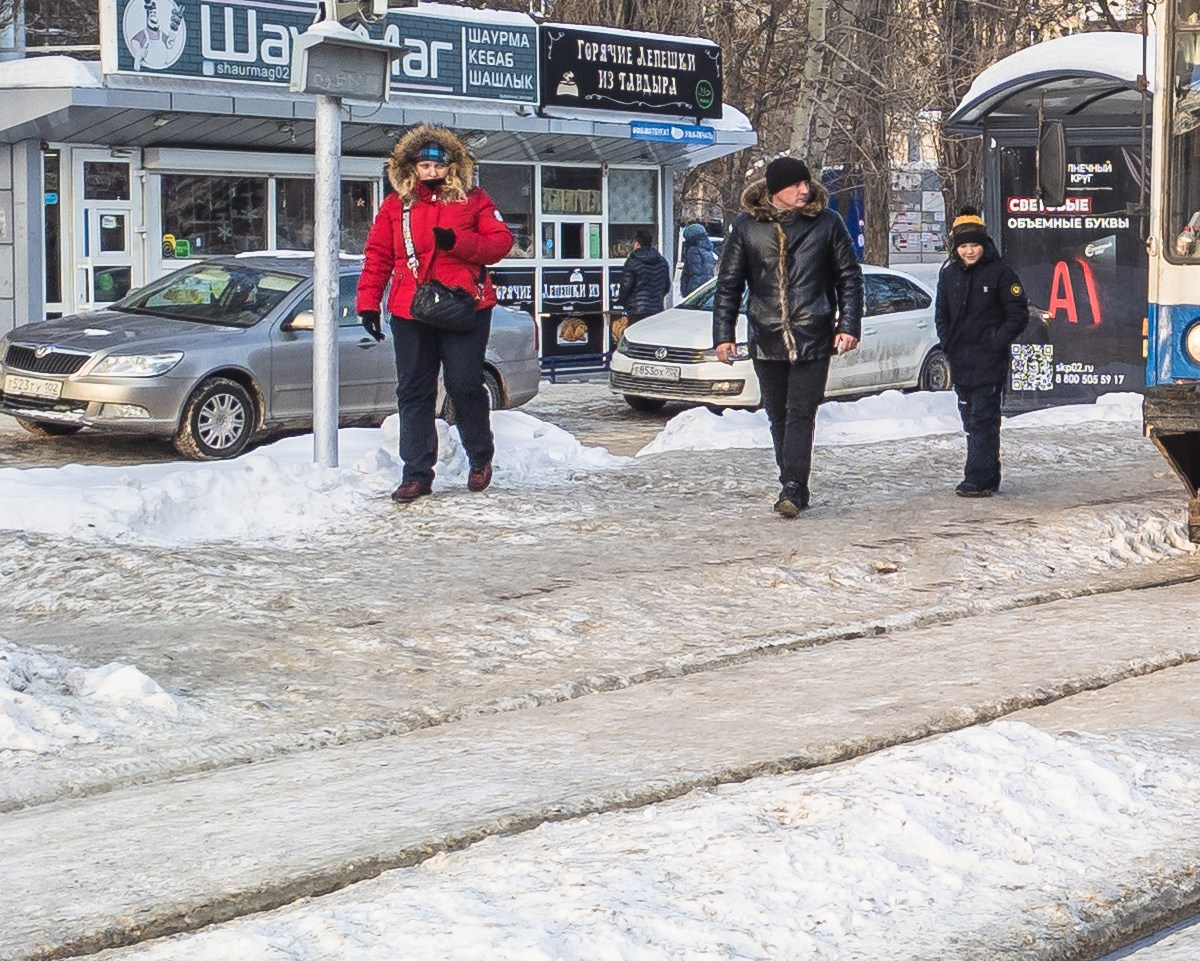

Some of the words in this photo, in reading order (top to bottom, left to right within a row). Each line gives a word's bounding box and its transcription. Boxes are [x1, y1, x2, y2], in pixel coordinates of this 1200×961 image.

[468, 27, 530, 48] ШАУРМА
[468, 51, 514, 68] КЕБАБ
[577, 39, 633, 65] ГОРЯЧИЕ
[636, 46, 696, 72] ЛЕПЕШКИ
[216, 64, 290, 81] shaurmag02
[469, 70, 533, 90] ШАШЛЫК
[598, 69, 614, 90] ИЗ
[619, 72, 678, 96] ТАНДЫРА
[1085, 217, 1130, 229] БУКВЫ
[1063, 373, 1080, 384] 800
[1081, 373, 1099, 385] 505
[1100, 374, 1112, 385] 59
[1114, 374, 1125, 385] 17
